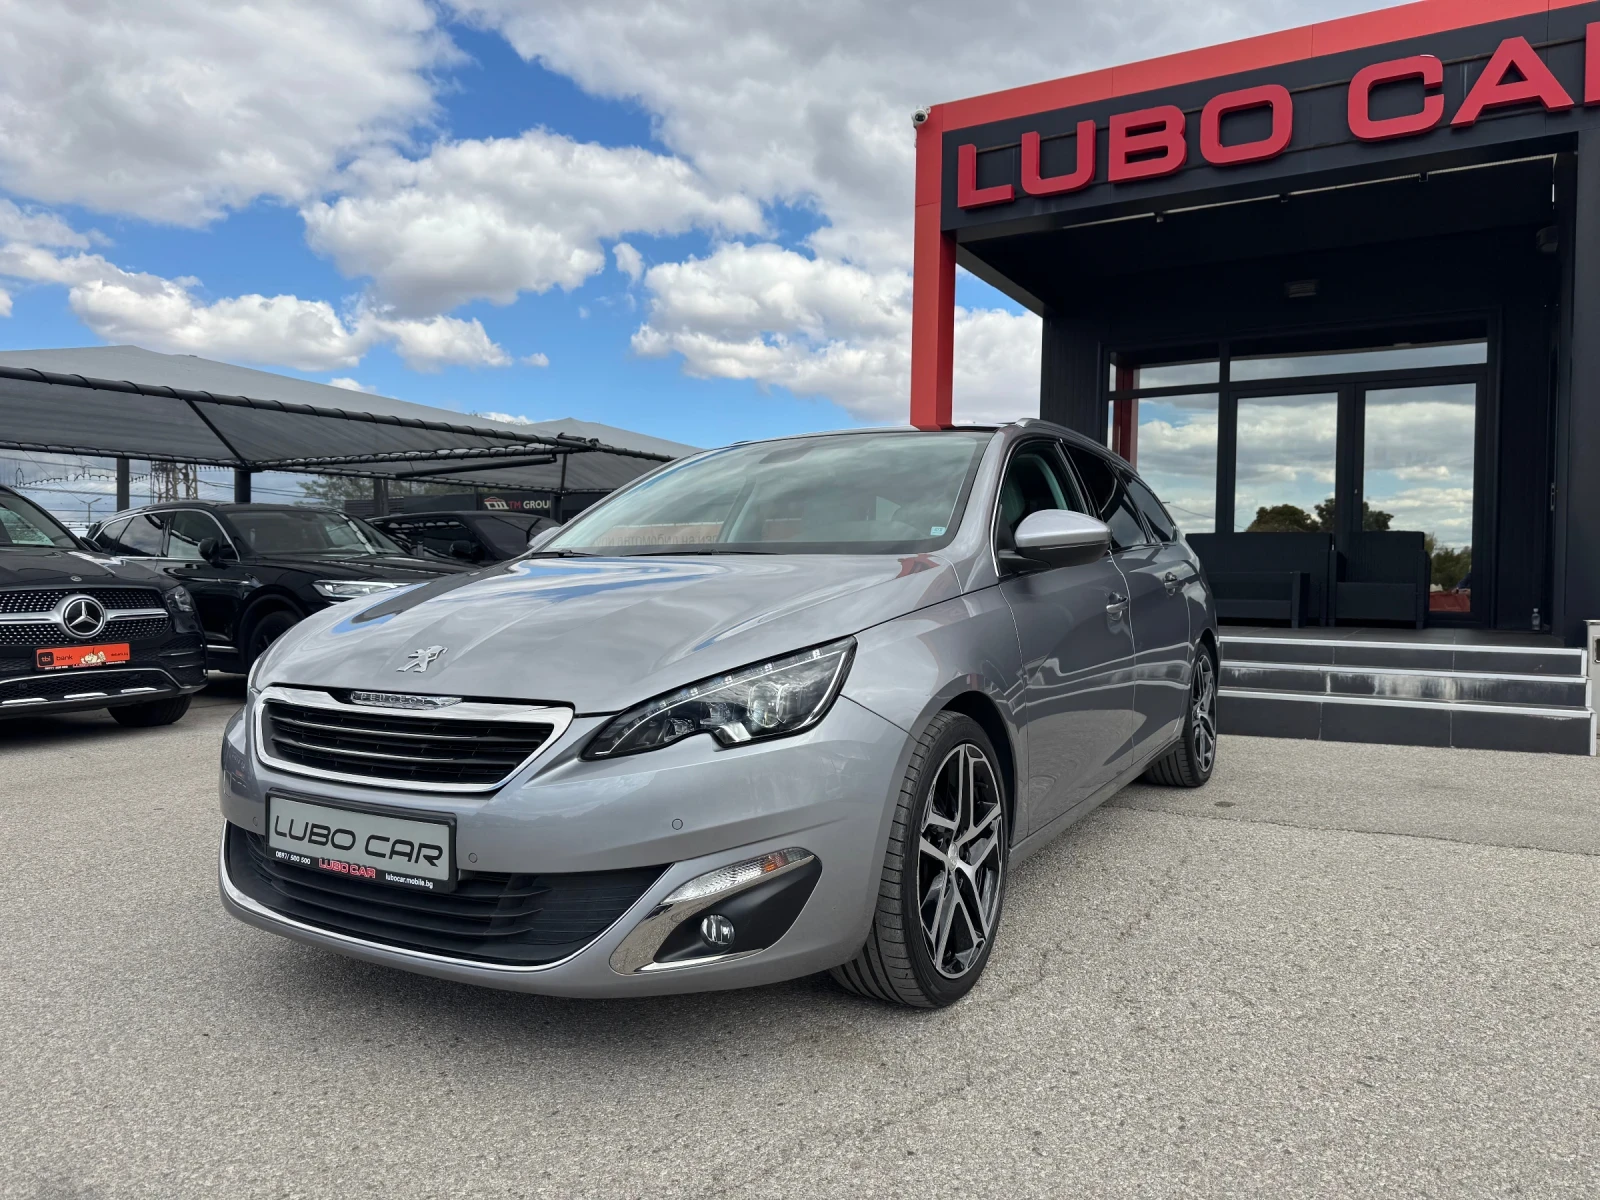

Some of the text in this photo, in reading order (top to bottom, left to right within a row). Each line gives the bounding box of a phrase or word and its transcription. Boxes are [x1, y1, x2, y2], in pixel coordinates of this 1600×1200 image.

[957, 83, 1293, 209] LUBO
[509, 501, 521, 510] TM
[523, 500, 551, 510] GROU
[360, 692, 429, 706] PEUGEOT
[274, 815, 444, 868] LUBO CAR
[318, 858, 376, 879] LUBO CAR
[385, 872, 434, 889] lubocar.mobile.bg
